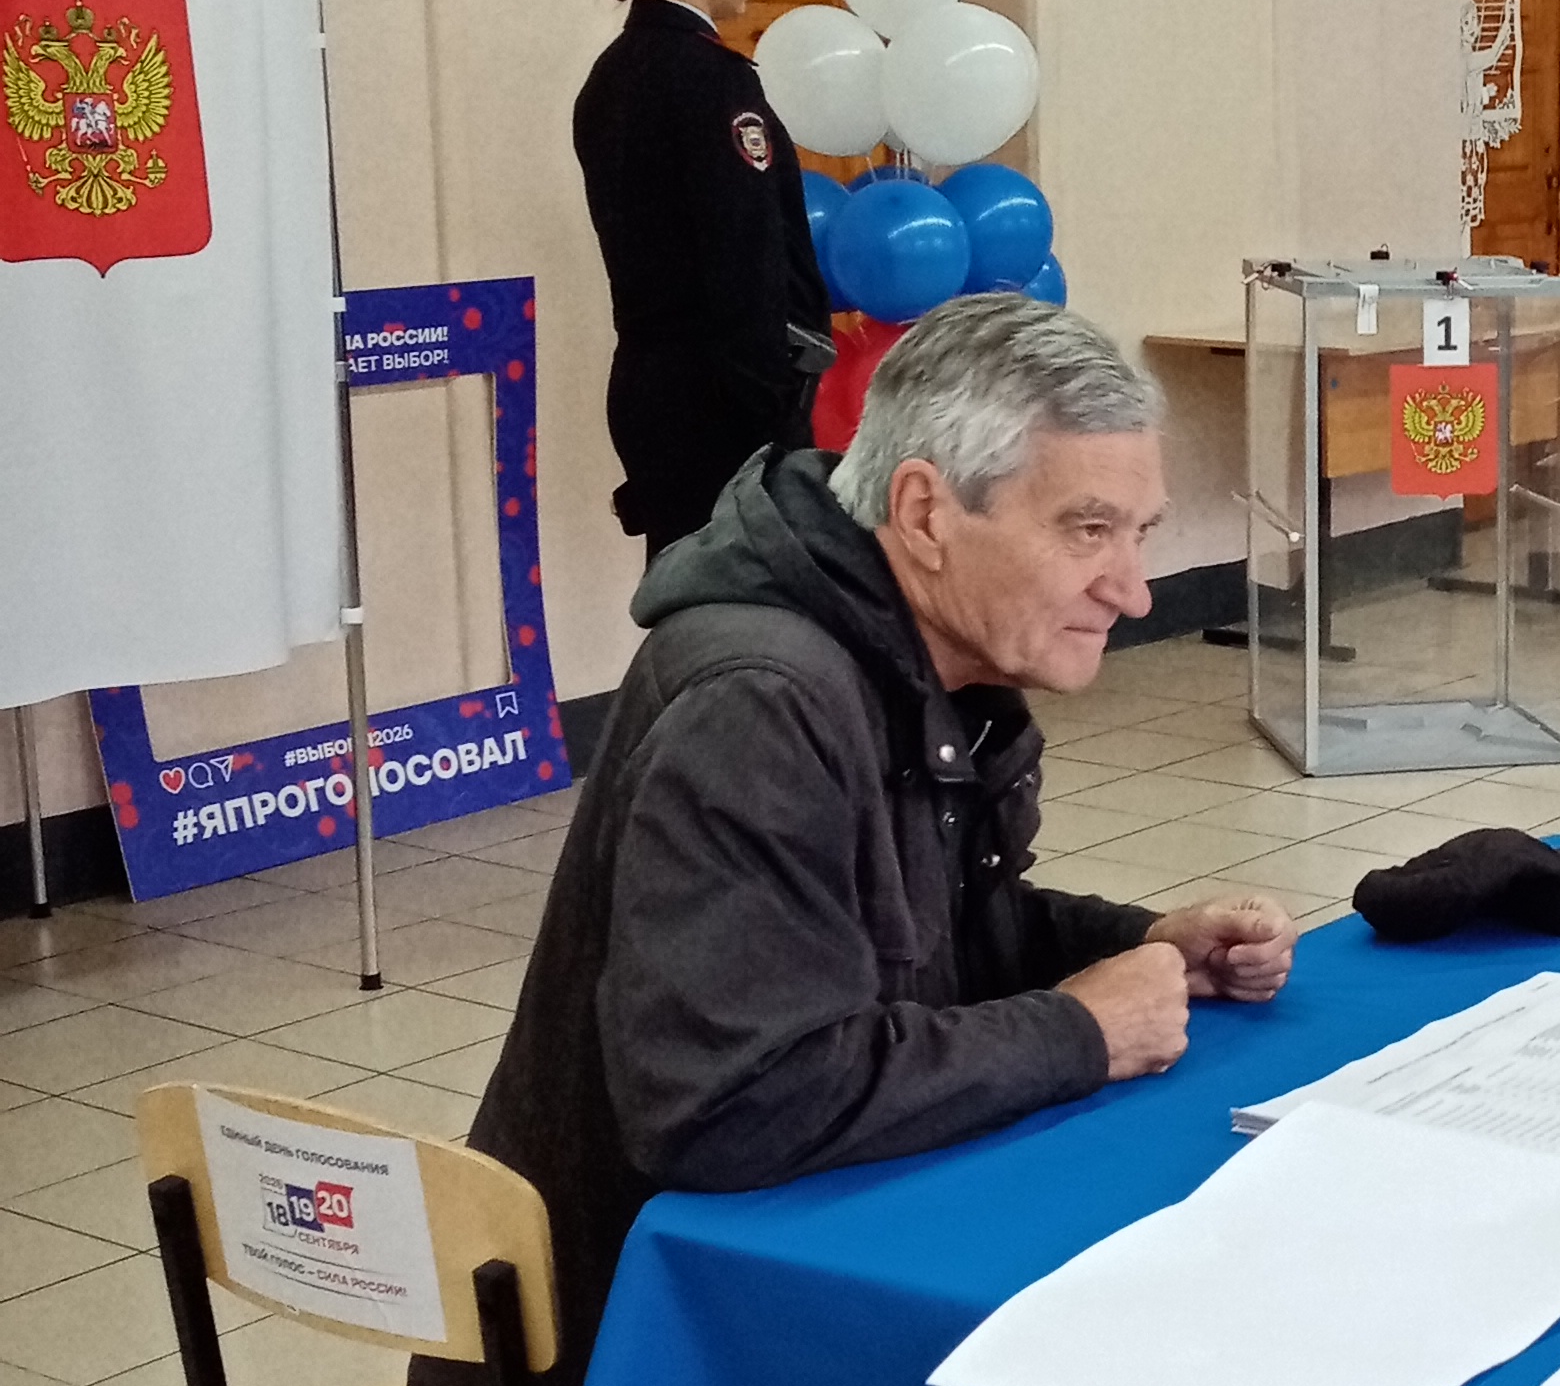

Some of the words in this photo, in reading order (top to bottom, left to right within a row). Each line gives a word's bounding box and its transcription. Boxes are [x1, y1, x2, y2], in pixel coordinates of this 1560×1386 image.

[367, 326, 448, 348] РОССИИ!
[1436, 315, 1459, 351] 1
[383, 348, 449, 371] ВЫБОР!
[283, 723, 413, 768] #ВЫБО2026
[295, 1148, 389, 1176] ГОЛОСОВАНИЯ
[266, 1201, 290, 1227] 18
[289, 1195, 316, 1222] 19
[316, 1190, 349, 1218] 20
[297, 1231, 360, 1255] СЕНТЯБРЯ
